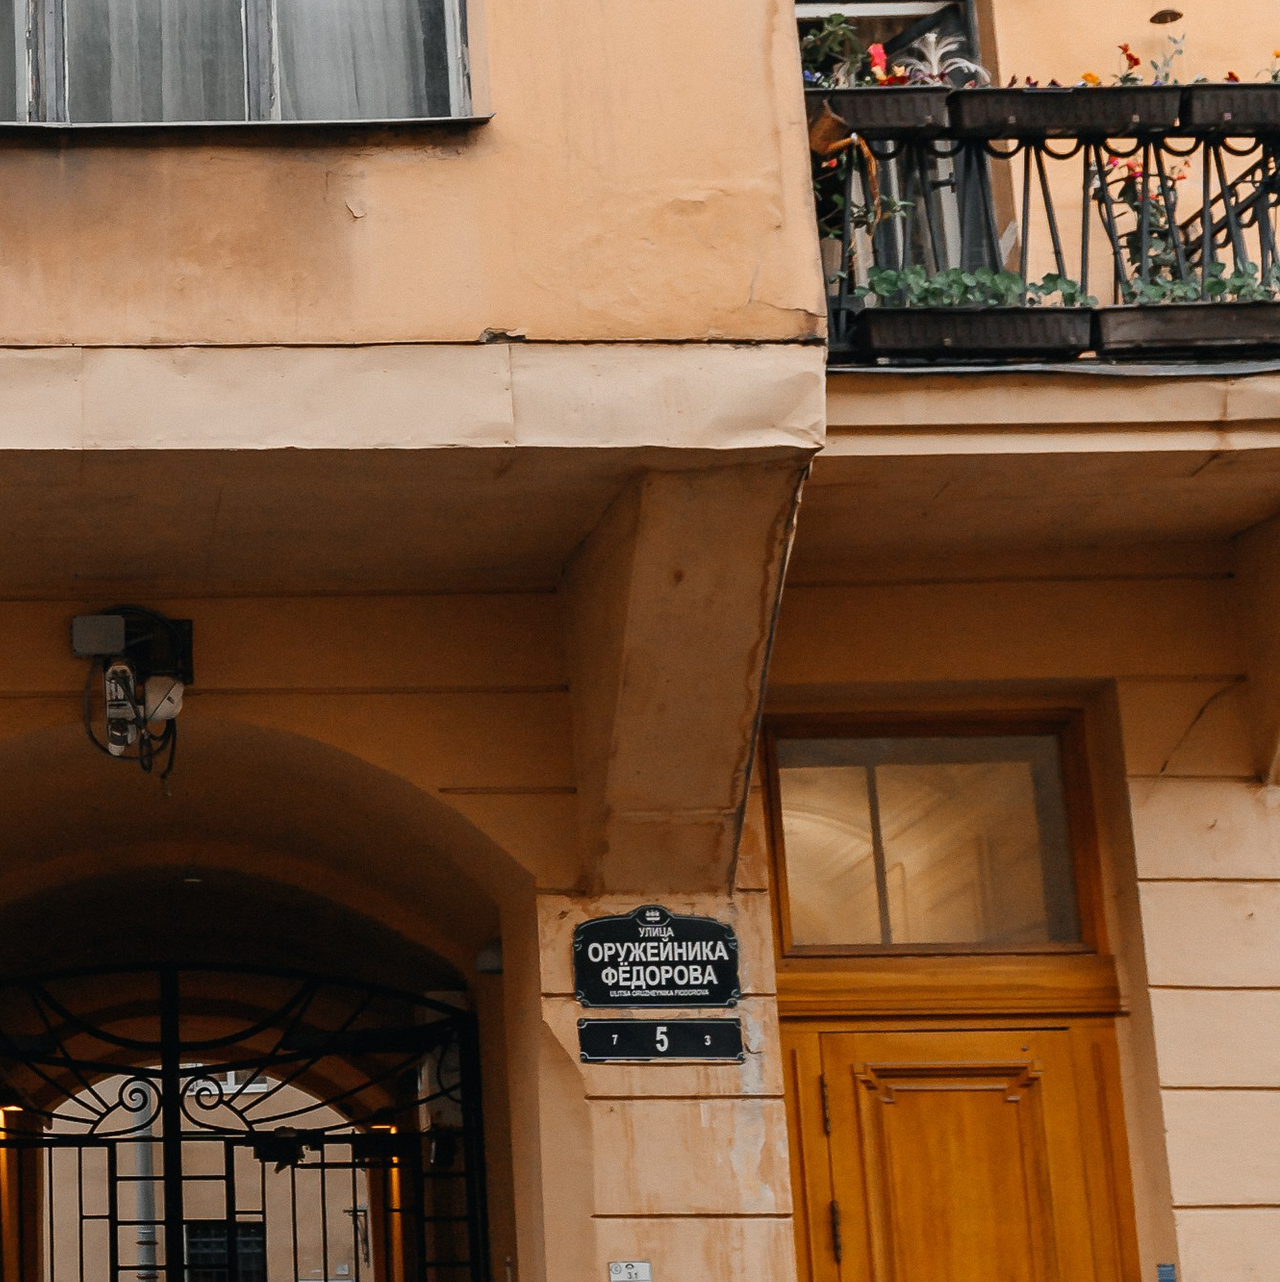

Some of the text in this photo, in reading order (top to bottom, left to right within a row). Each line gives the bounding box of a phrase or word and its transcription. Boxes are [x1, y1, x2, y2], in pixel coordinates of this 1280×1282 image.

[638, 926, 675, 938] УЛИЦА
[587, 937, 729, 963] ОРУЖЕЙНИКА
[601, 962, 719, 989] ФЁДОРОВА
[611, 1026, 711, 1052] 7 5 3
